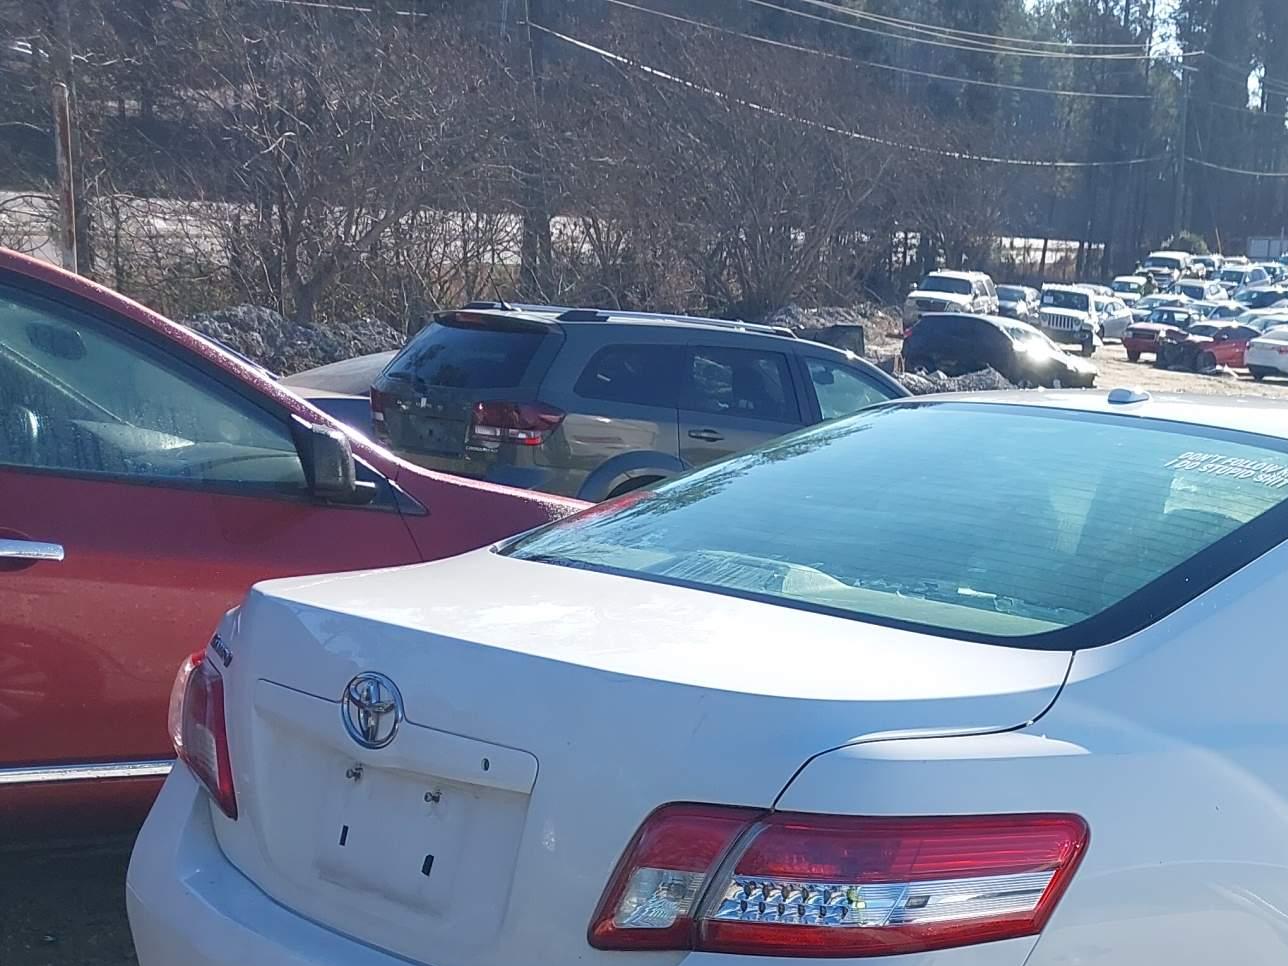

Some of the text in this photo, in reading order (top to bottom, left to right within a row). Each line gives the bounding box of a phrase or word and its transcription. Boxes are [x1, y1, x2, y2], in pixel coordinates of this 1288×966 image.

[1164, 459, 1178, 468] I
[1175, 460, 1199, 470] DO
[1199, 463, 1255, 479] STUPID
[1178, 451, 1226, 463] DON'T
[1222, 457, 1277, 473] FOLLOW
